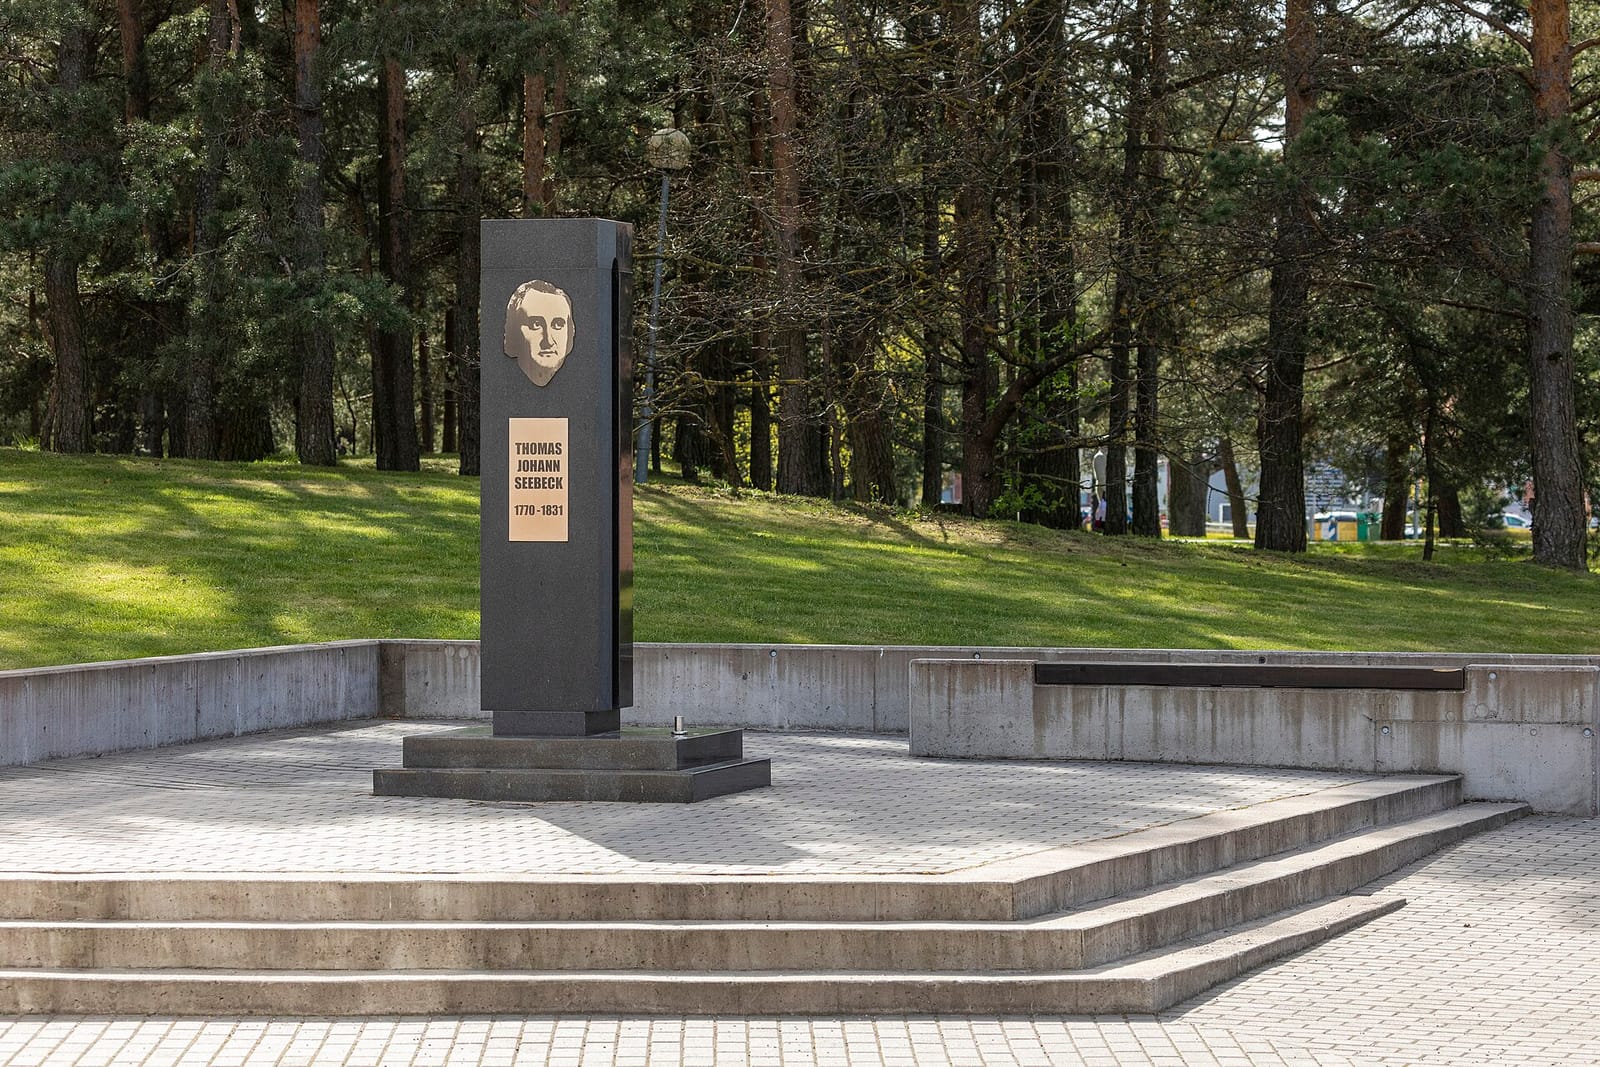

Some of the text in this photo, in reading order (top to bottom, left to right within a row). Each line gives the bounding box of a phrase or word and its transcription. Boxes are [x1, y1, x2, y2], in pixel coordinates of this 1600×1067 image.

[515, 442, 562, 455] THOMAS
[517, 460, 560, 472] JOHANN
[514, 477, 563, 490] SEEBECK
